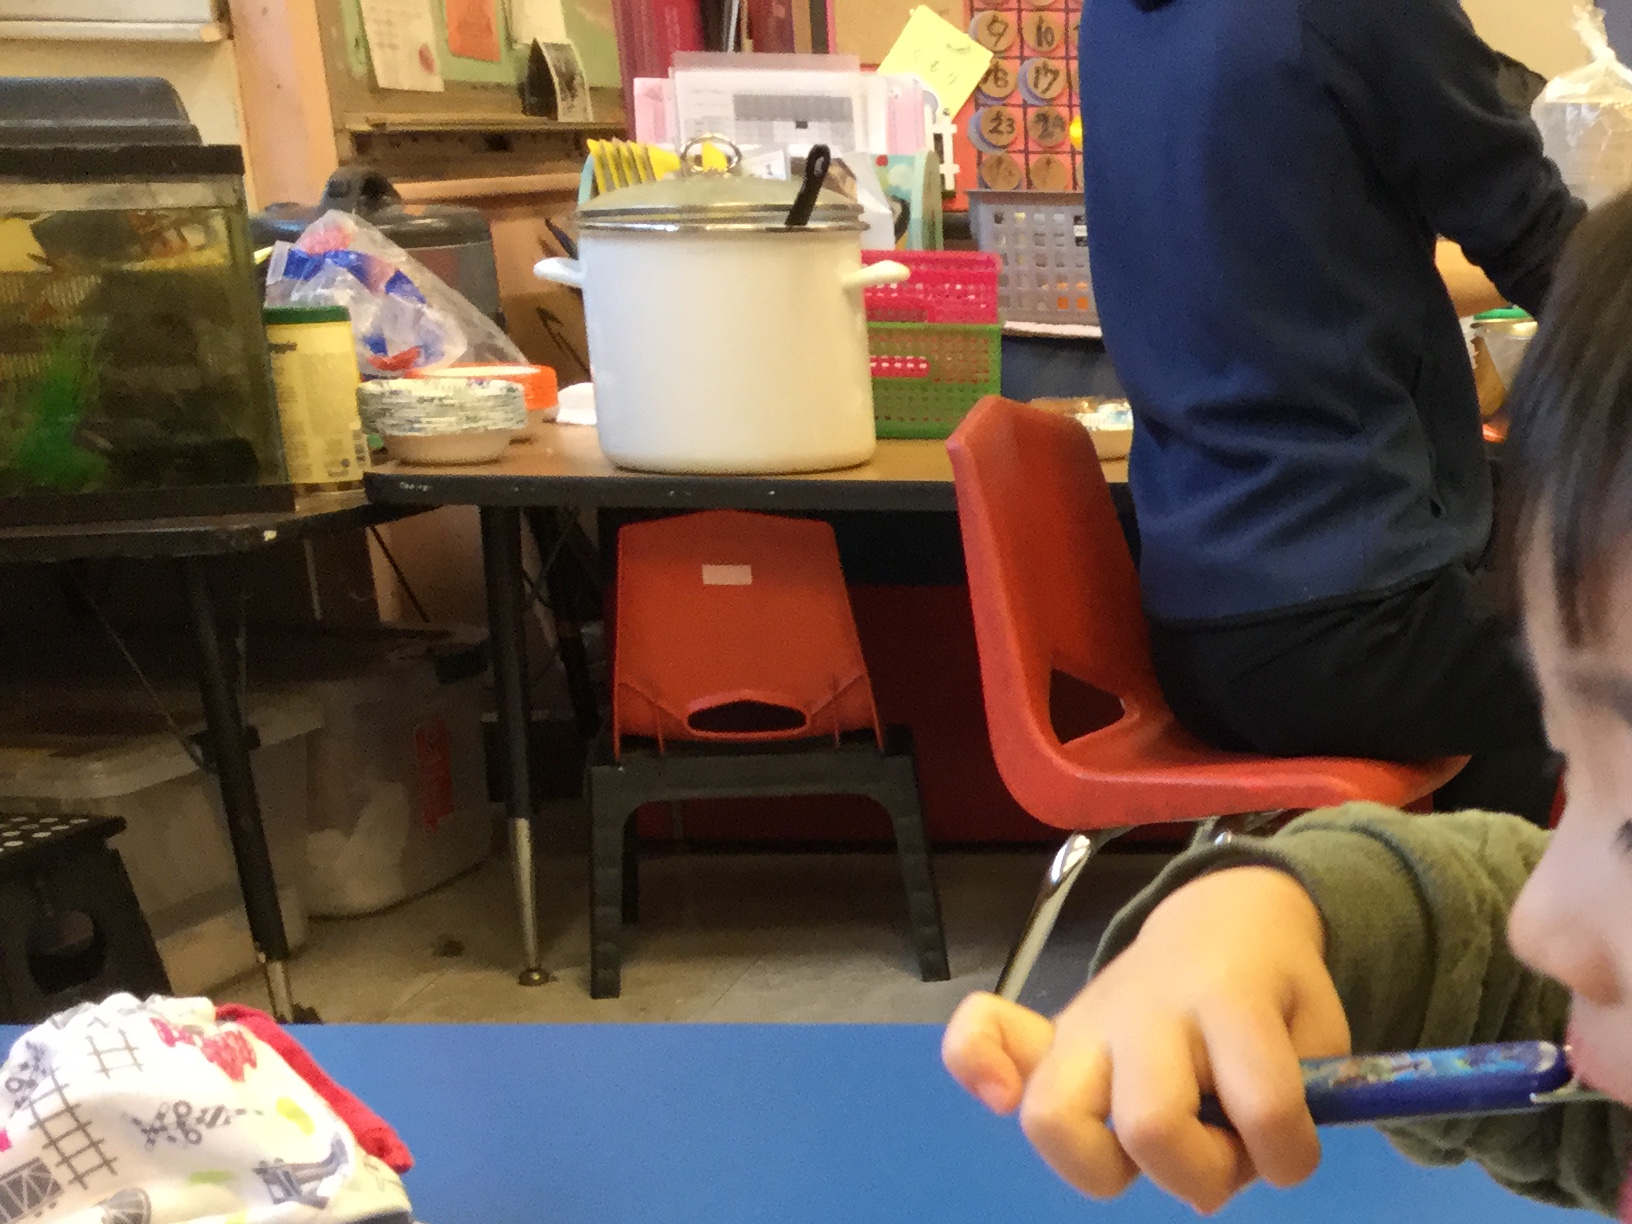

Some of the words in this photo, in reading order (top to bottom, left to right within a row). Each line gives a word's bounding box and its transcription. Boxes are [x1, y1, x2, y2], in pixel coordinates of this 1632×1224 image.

[986, 15, 1009, 47] 9
[1036, 19, 1056, 48] 10
[1033, 64, 1060, 95] 17
[988, 112, 1016, 135] 23
